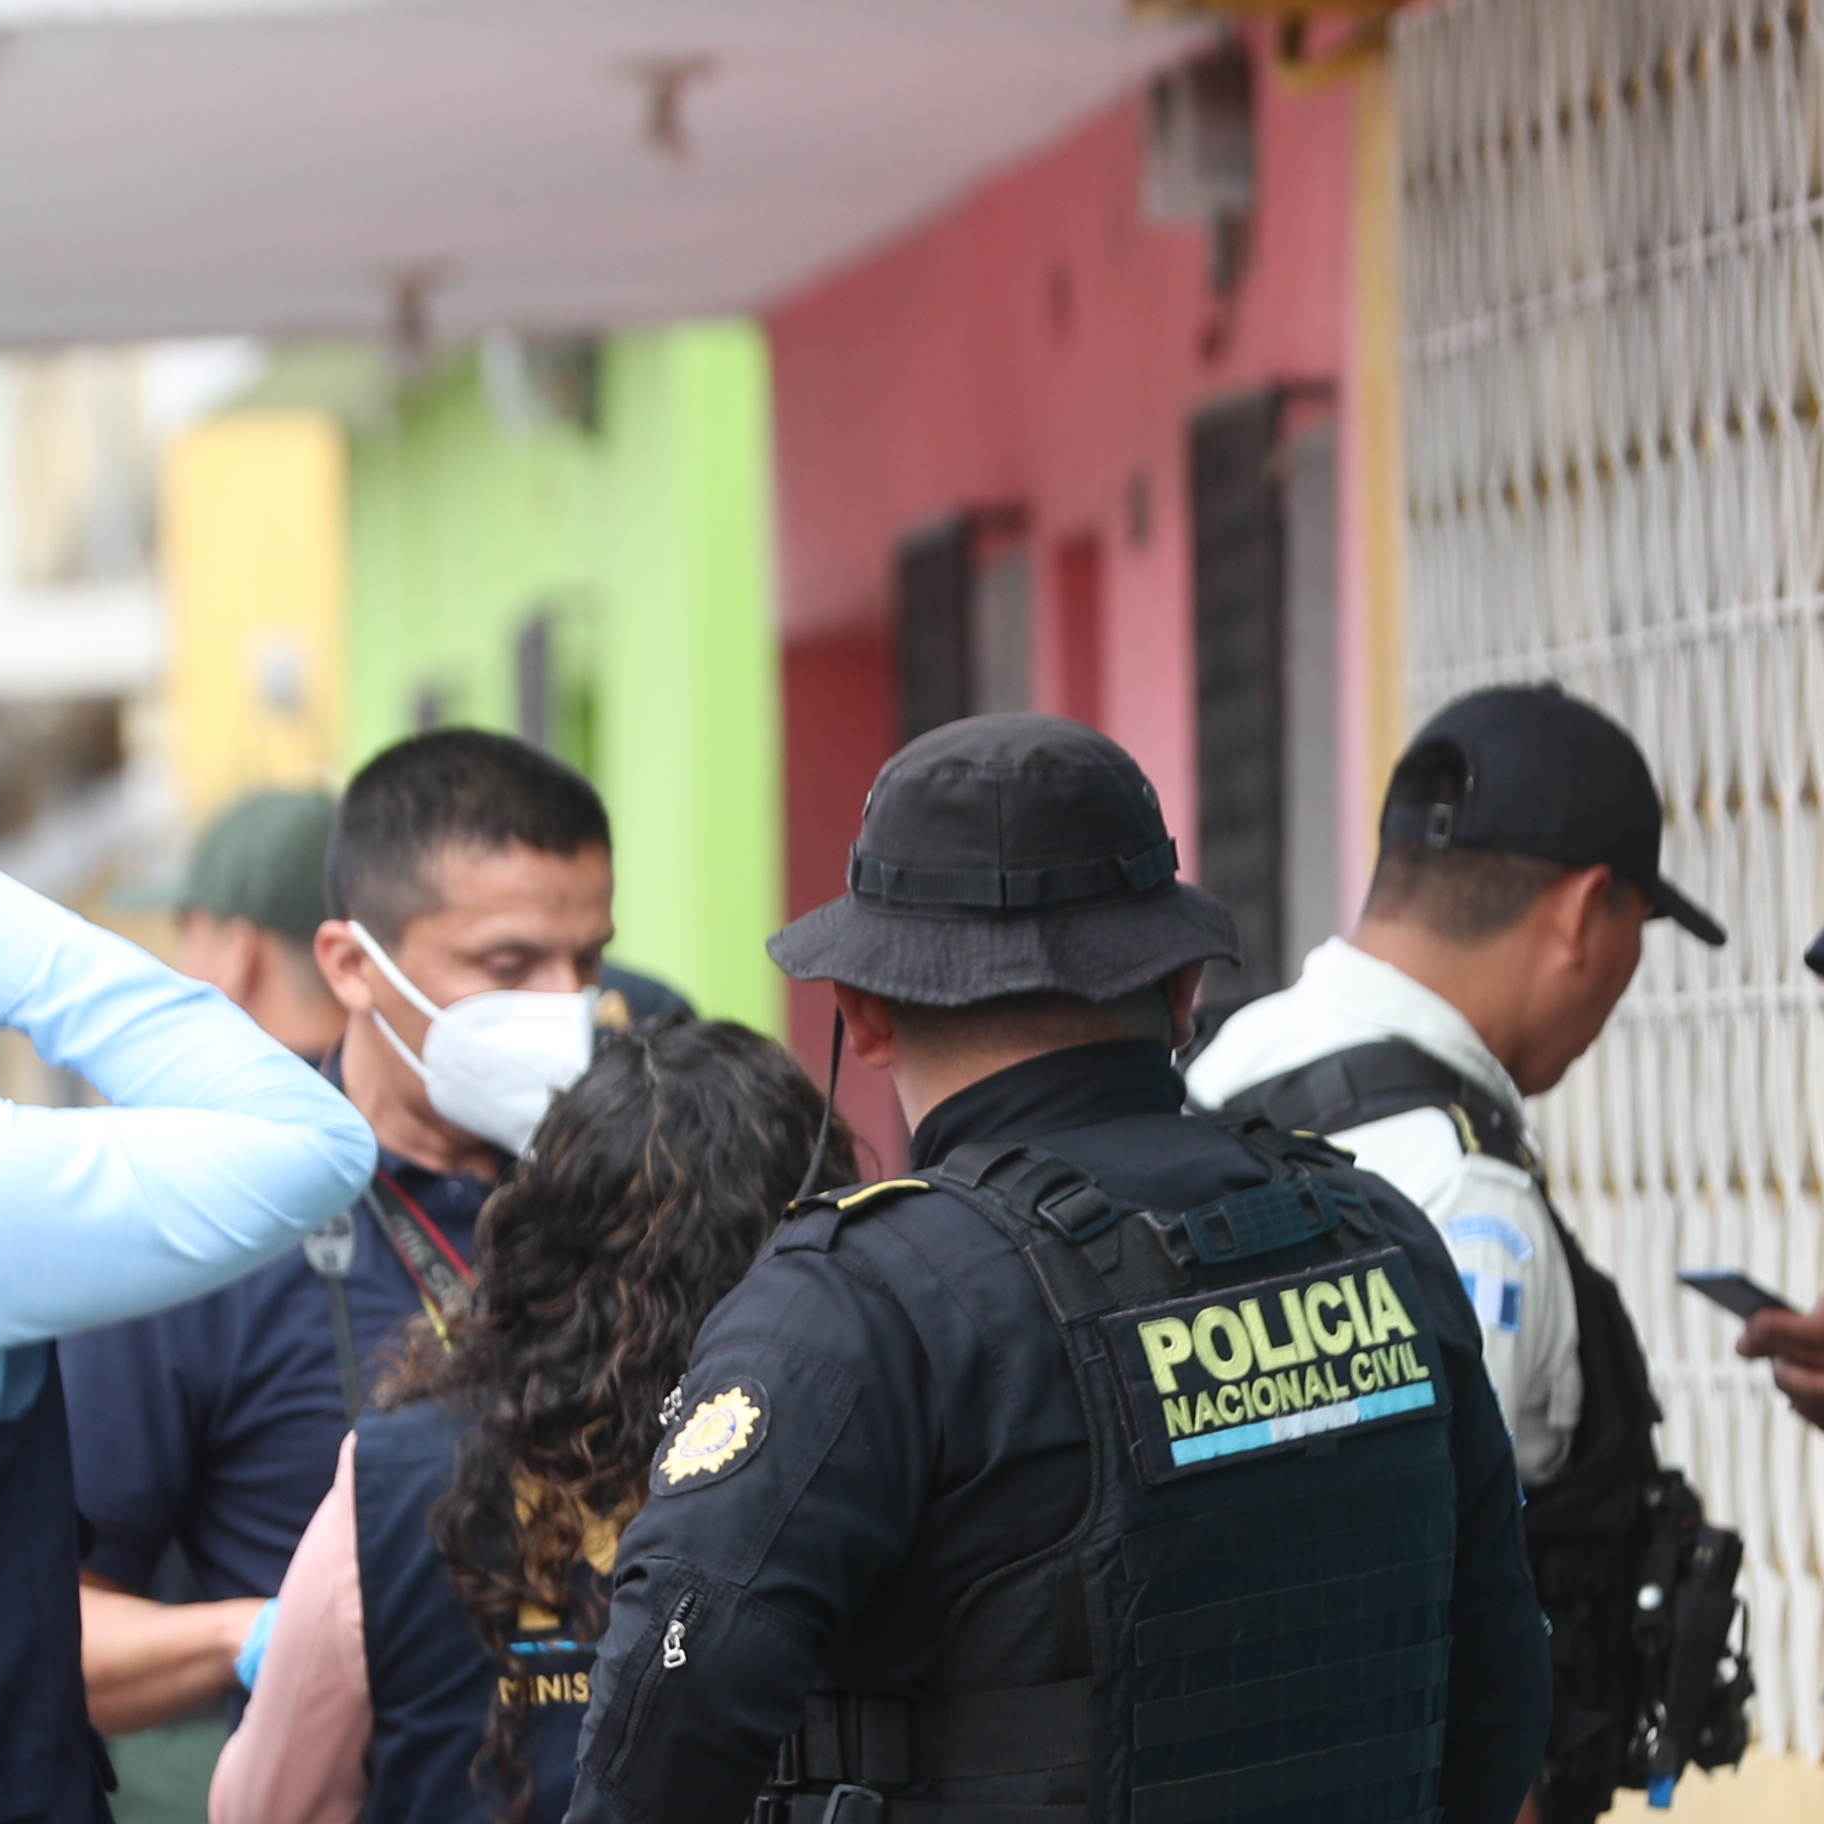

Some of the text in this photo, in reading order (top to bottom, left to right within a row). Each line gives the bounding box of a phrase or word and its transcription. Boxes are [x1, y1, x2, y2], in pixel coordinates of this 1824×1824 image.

[1137, 1267, 1418, 1394] POLICIA
[1161, 1341, 1430, 1438] NACIONAL CIVIL
